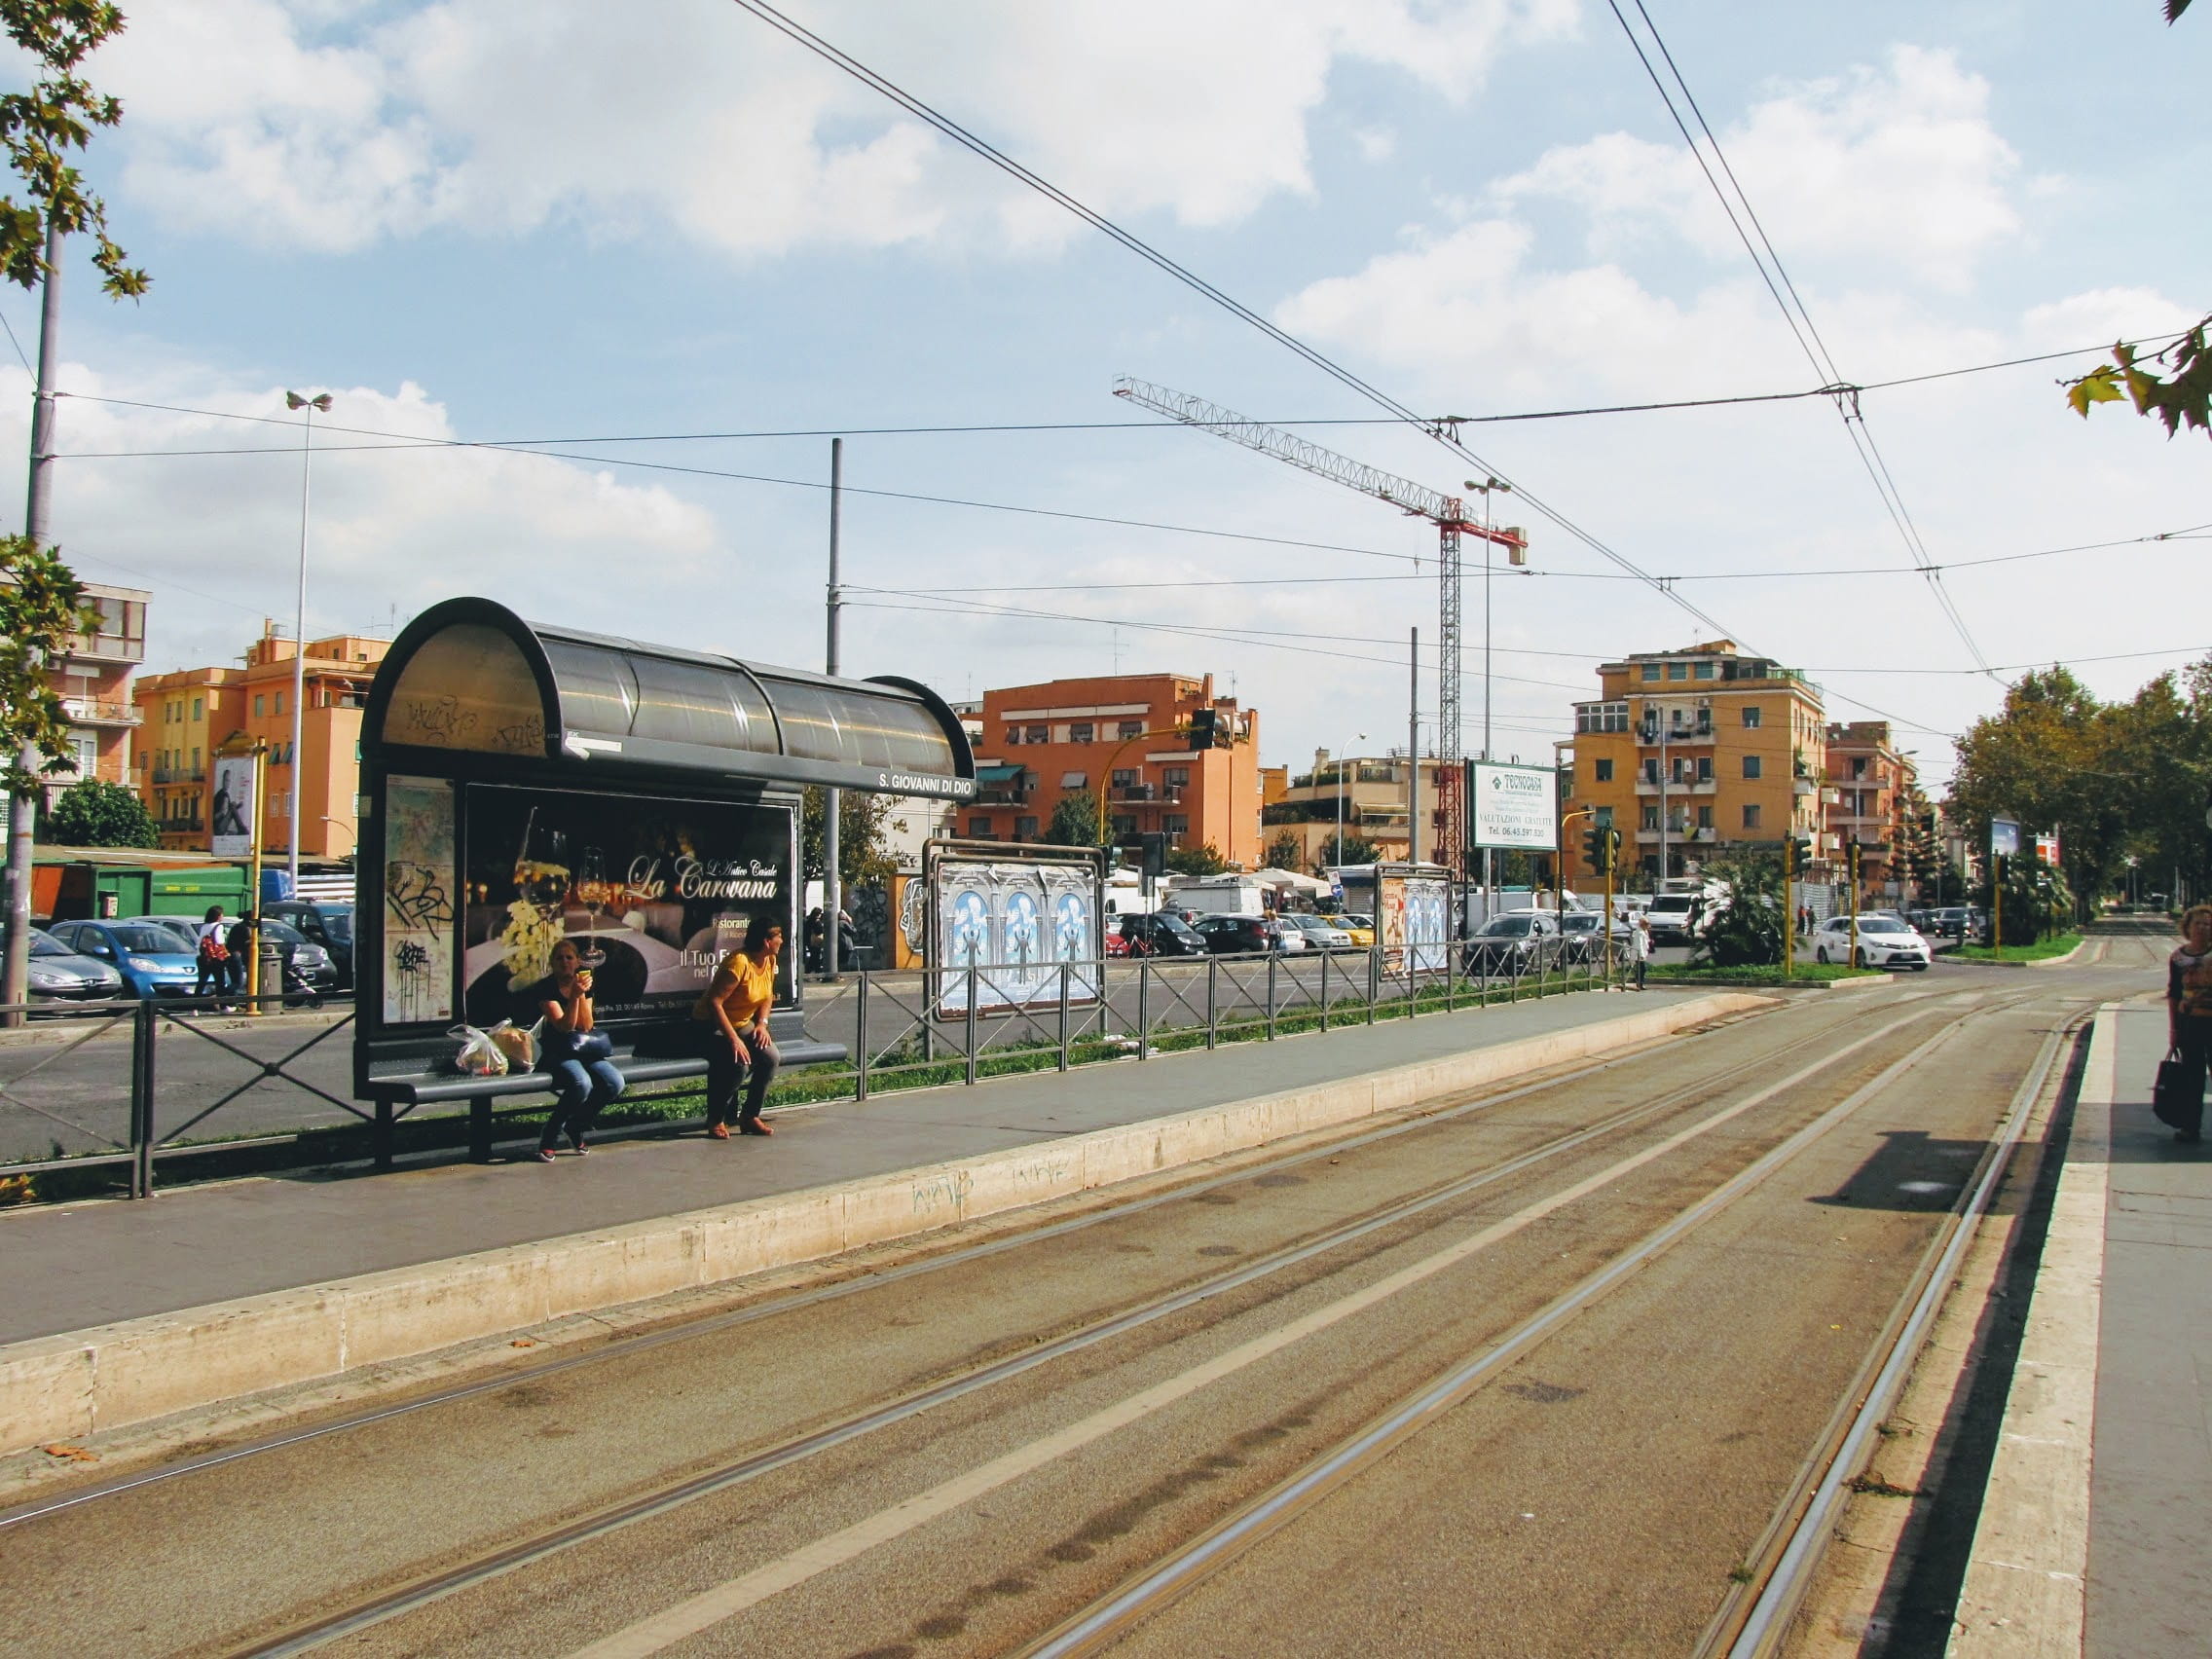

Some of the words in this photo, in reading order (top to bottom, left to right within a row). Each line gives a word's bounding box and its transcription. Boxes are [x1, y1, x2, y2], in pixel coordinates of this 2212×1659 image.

[879, 773, 889, 788] S.
[891, 775, 940, 792] GIOVANNI
[941, 779, 952, 793] DI
[954, 781, 972, 794] DIO
[750, 859, 778, 876] Casale
[624, 855, 666, 900] La
[675, 856, 778, 899] Carovana
[680, 948, 687, 967] Il
[691, 950, 717, 966] Tuo
[693, 965, 709, 978] nel
